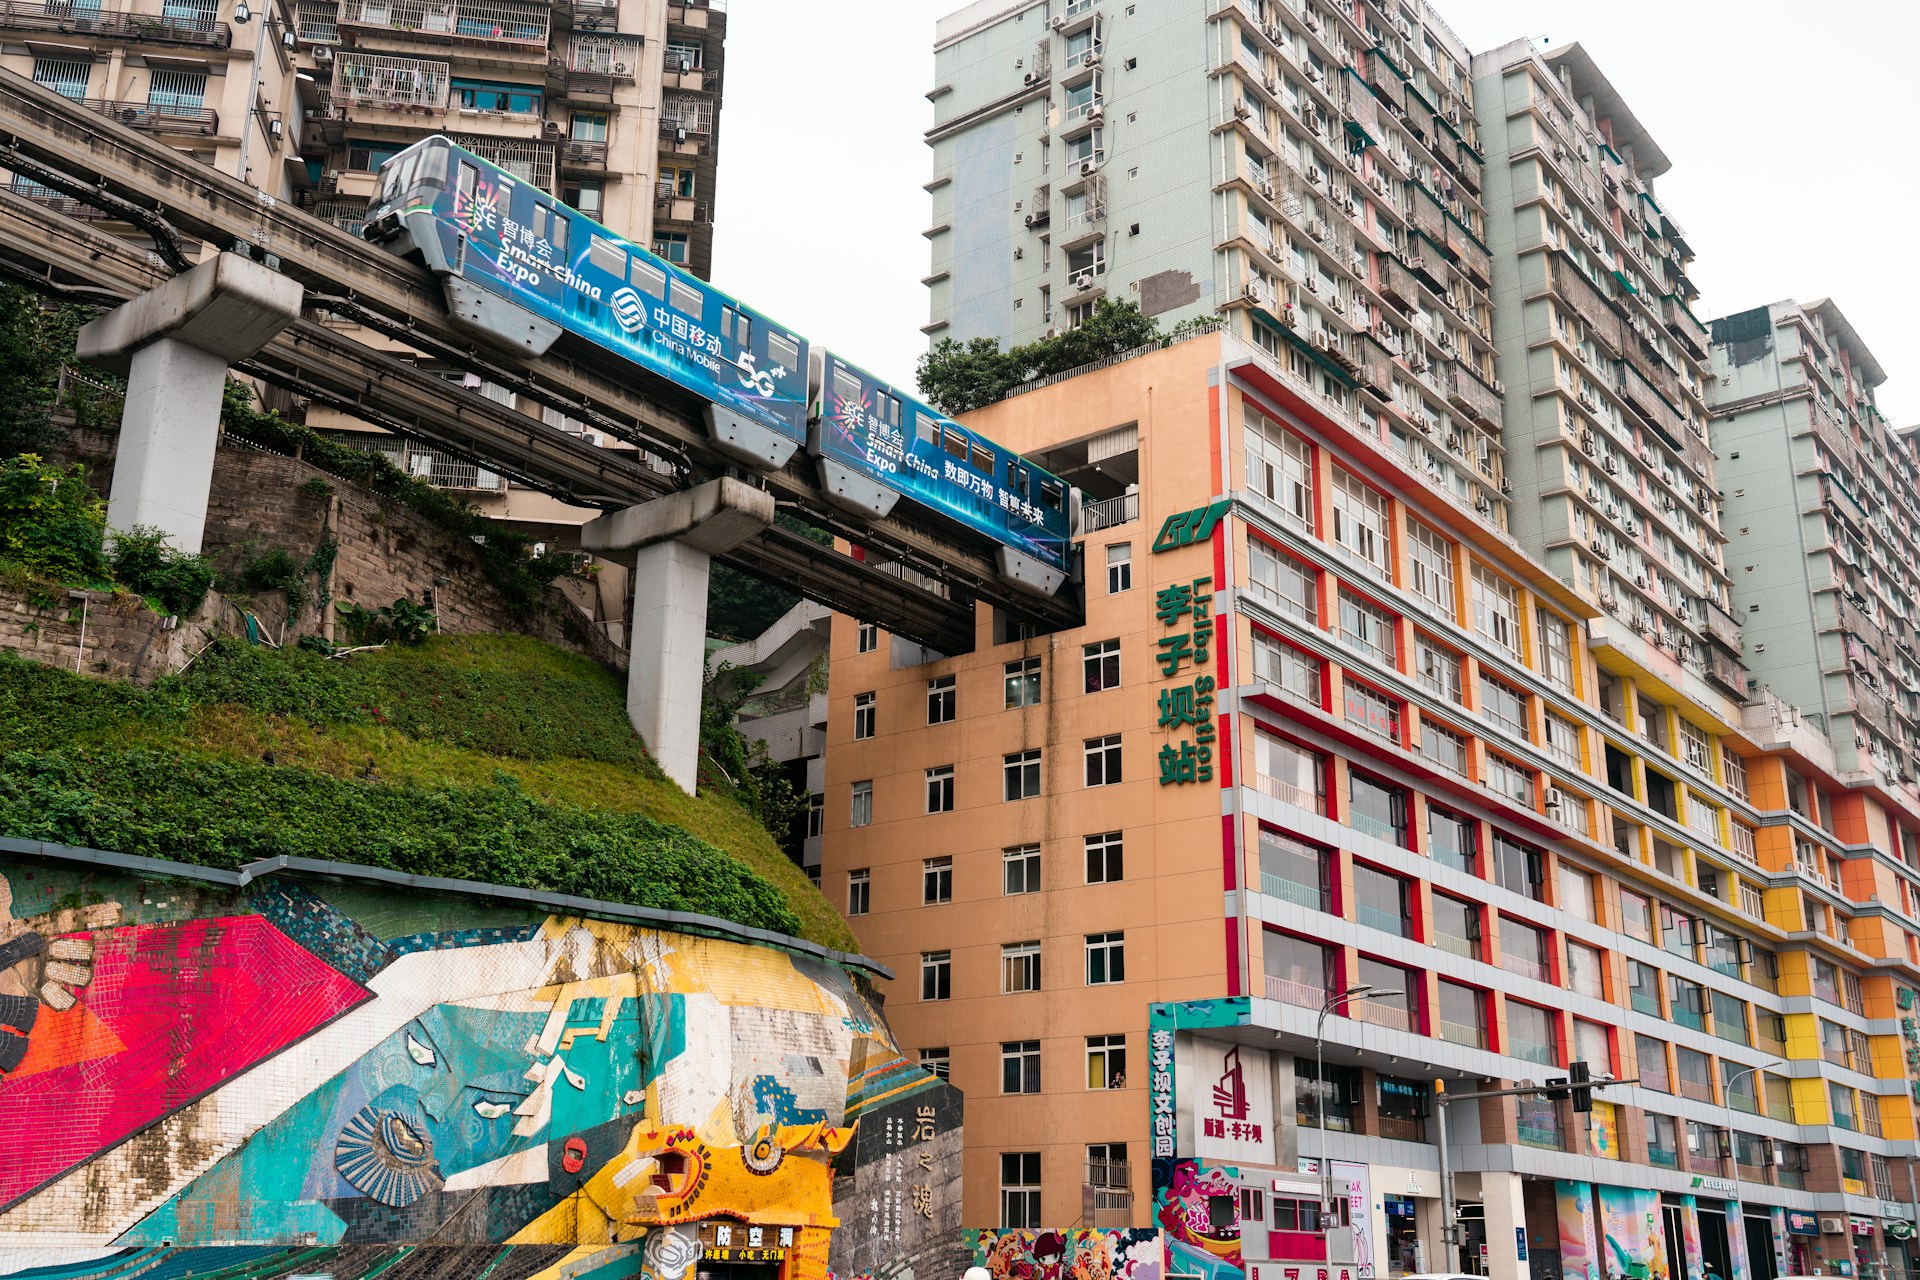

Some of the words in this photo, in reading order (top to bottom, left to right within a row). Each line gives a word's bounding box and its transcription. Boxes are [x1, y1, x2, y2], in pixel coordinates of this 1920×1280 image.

[502, 217, 553, 259] 智博会
[497, 251, 540, 286] Expo
[500, 238, 551, 275] Smart
[554, 264, 602, 300] China
[652, 329, 685, 353] China
[686, 347, 721, 374] Mobile
[653, 307, 722, 357] 中国移动
[868, 414, 905, 447] 智博会
[866, 447, 897, 474] Expo
[867, 432, 904, 463] Smart
[905, 452, 939, 480] China
[944, 460, 994, 500] 数即万物
[998, 488, 1044, 526] 智算未来
[1192, 576, 1213, 664] Liziba
[1156, 584, 1196, 785] 李子坝站
[1194, 675, 1216, 782] Station
[1151, 1029, 1174, 1158] 李子坝文创园
[911, 1105, 936, 1220] 岩之魂
[704, 1249, 730, 1260] 许愿墙
[738, 1249, 755, 1260] 小吃
[761, 1249, 785, 1260] 无门票
[716, 1225, 794, 1248] 防空洞
